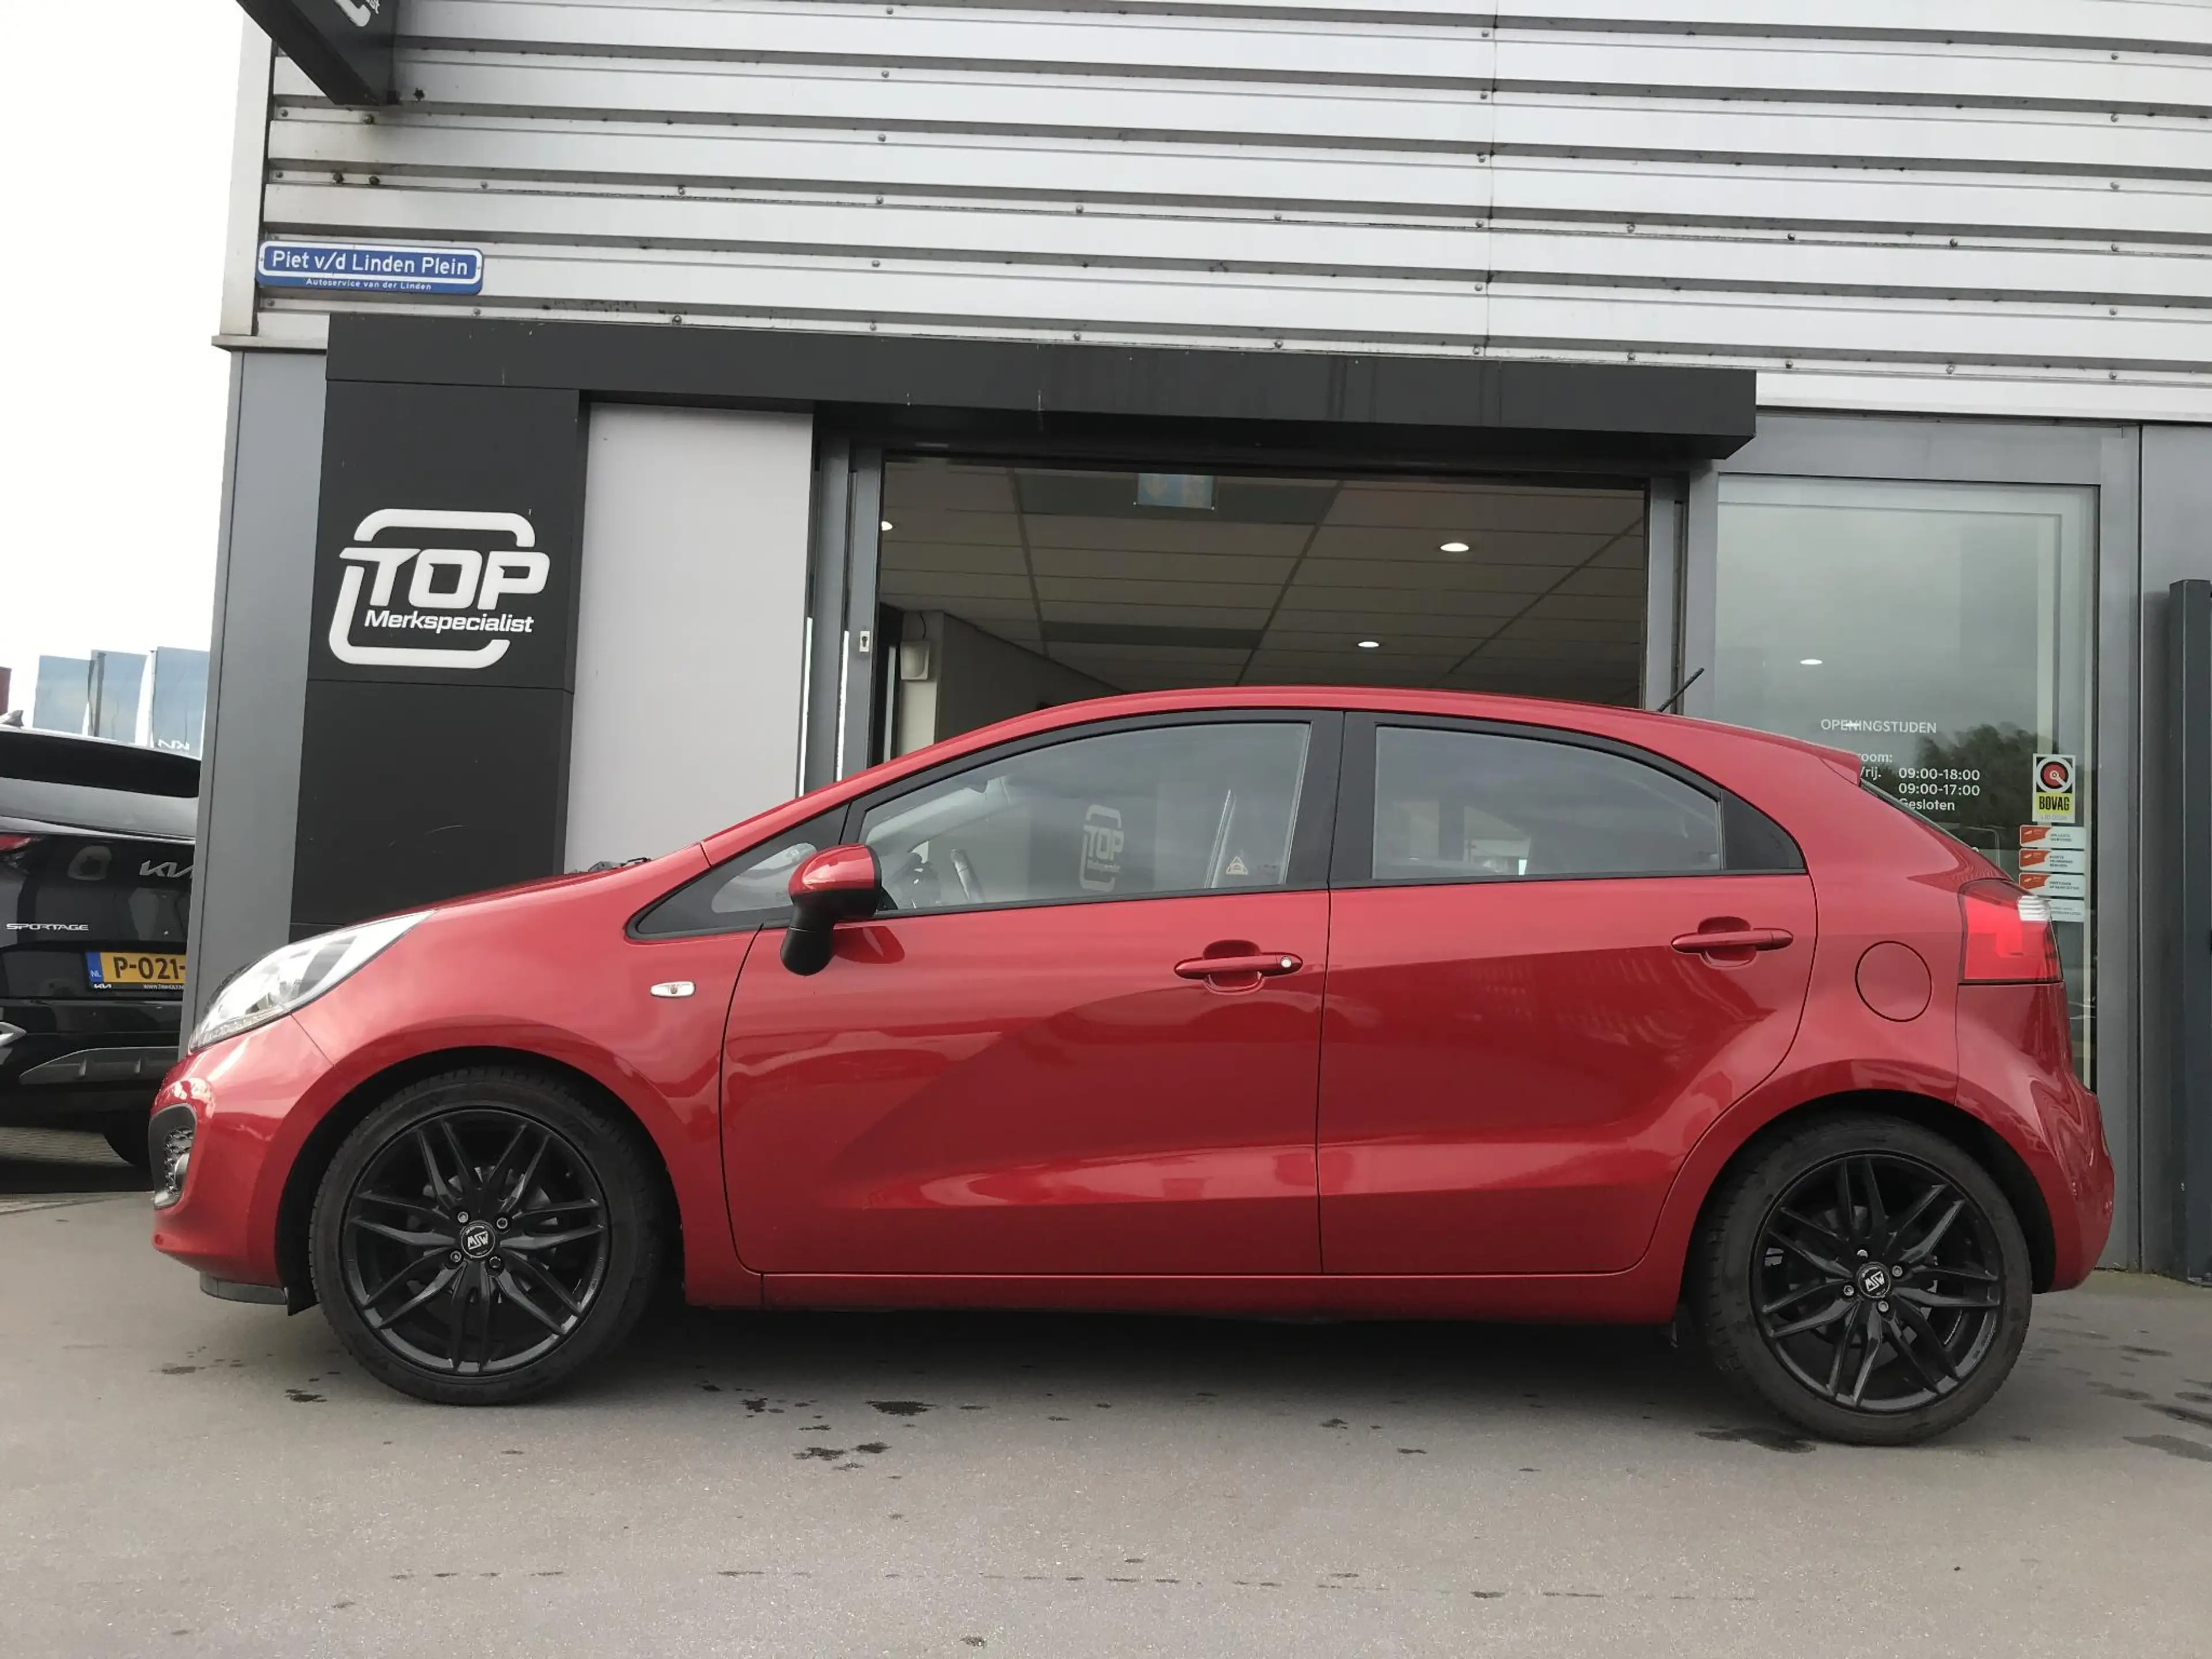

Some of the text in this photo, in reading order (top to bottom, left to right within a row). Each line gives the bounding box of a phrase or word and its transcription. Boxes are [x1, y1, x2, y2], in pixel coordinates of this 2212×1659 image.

[272, 249, 468, 275] Piet v/d Linden Plein
[305, 278, 360, 287] Autoservice
[382, 281, 397, 289] der
[400, 282, 431, 290] Linden
[339, 547, 551, 610] TOP
[364, 609, 535, 634] Merkspecialist
[1820, 718, 1937, 733] OPENINGSTIJDEN
[1898, 768, 1980, 781] 09:00-18:00
[1898, 783, 1980, 796] 09:00-17:00
[1899, 798, 1956, 811] Gesloten
[2039, 796, 2070, 810] BOVAG
[6, 923, 89, 931] SPORTAGE
[90, 969, 102, 978] NL
[467, 1230, 488, 1250] MSW
[1865, 1271, 1885, 1291] MSW
